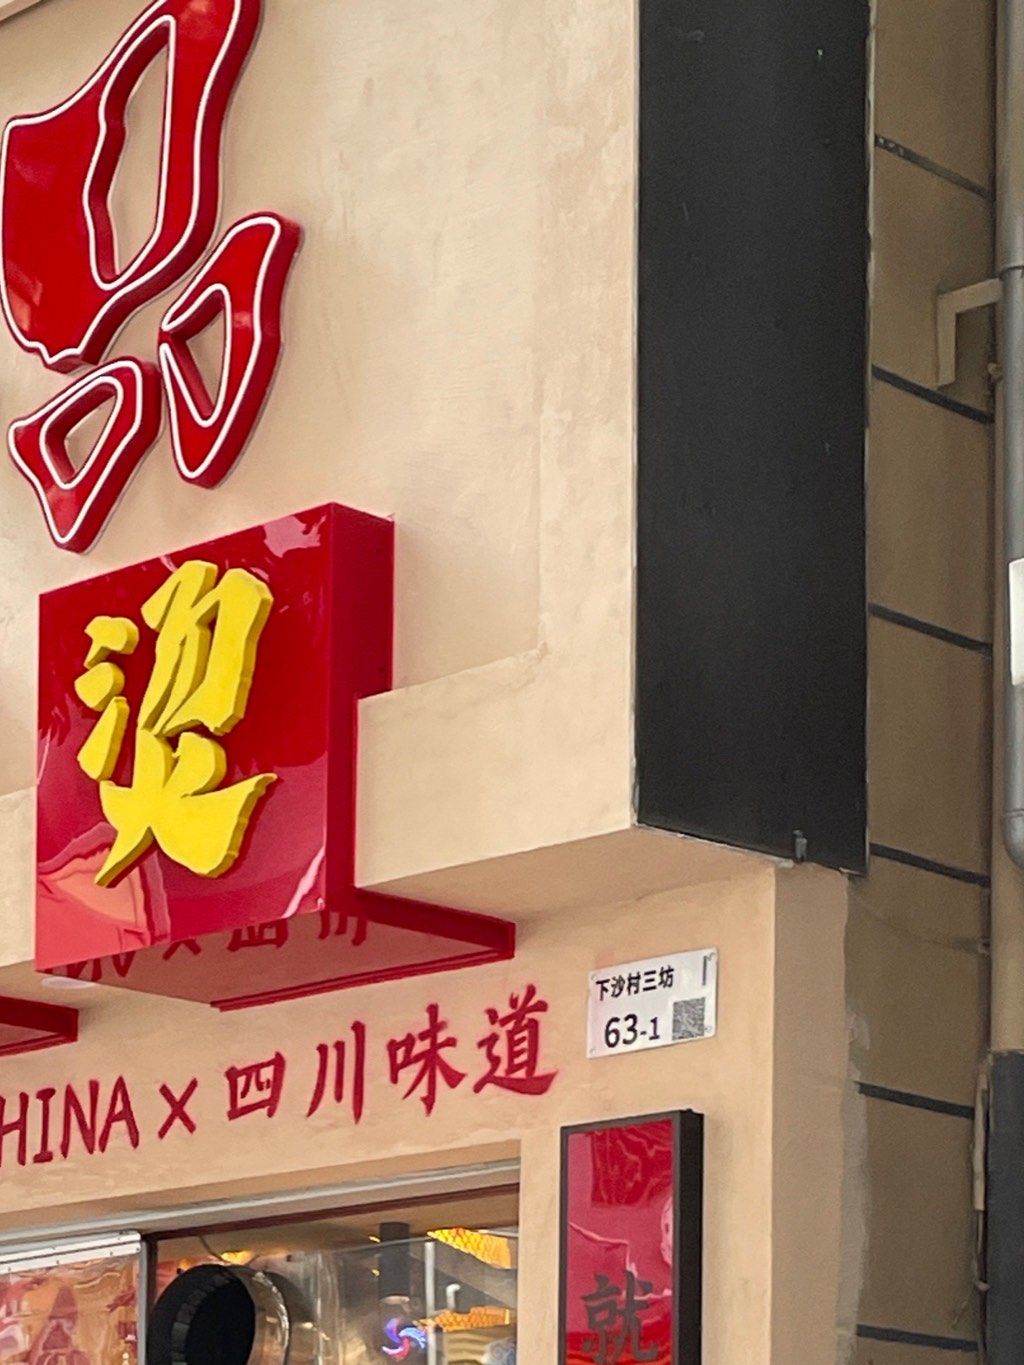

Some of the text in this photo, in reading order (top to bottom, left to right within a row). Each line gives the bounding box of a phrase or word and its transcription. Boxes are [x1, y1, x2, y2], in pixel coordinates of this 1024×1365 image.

[596, 965, 674, 1001] 下沙村三坊
[605, 1013, 660, 1048] 63-1
[226, 983, 562, 1126] 四川味道
